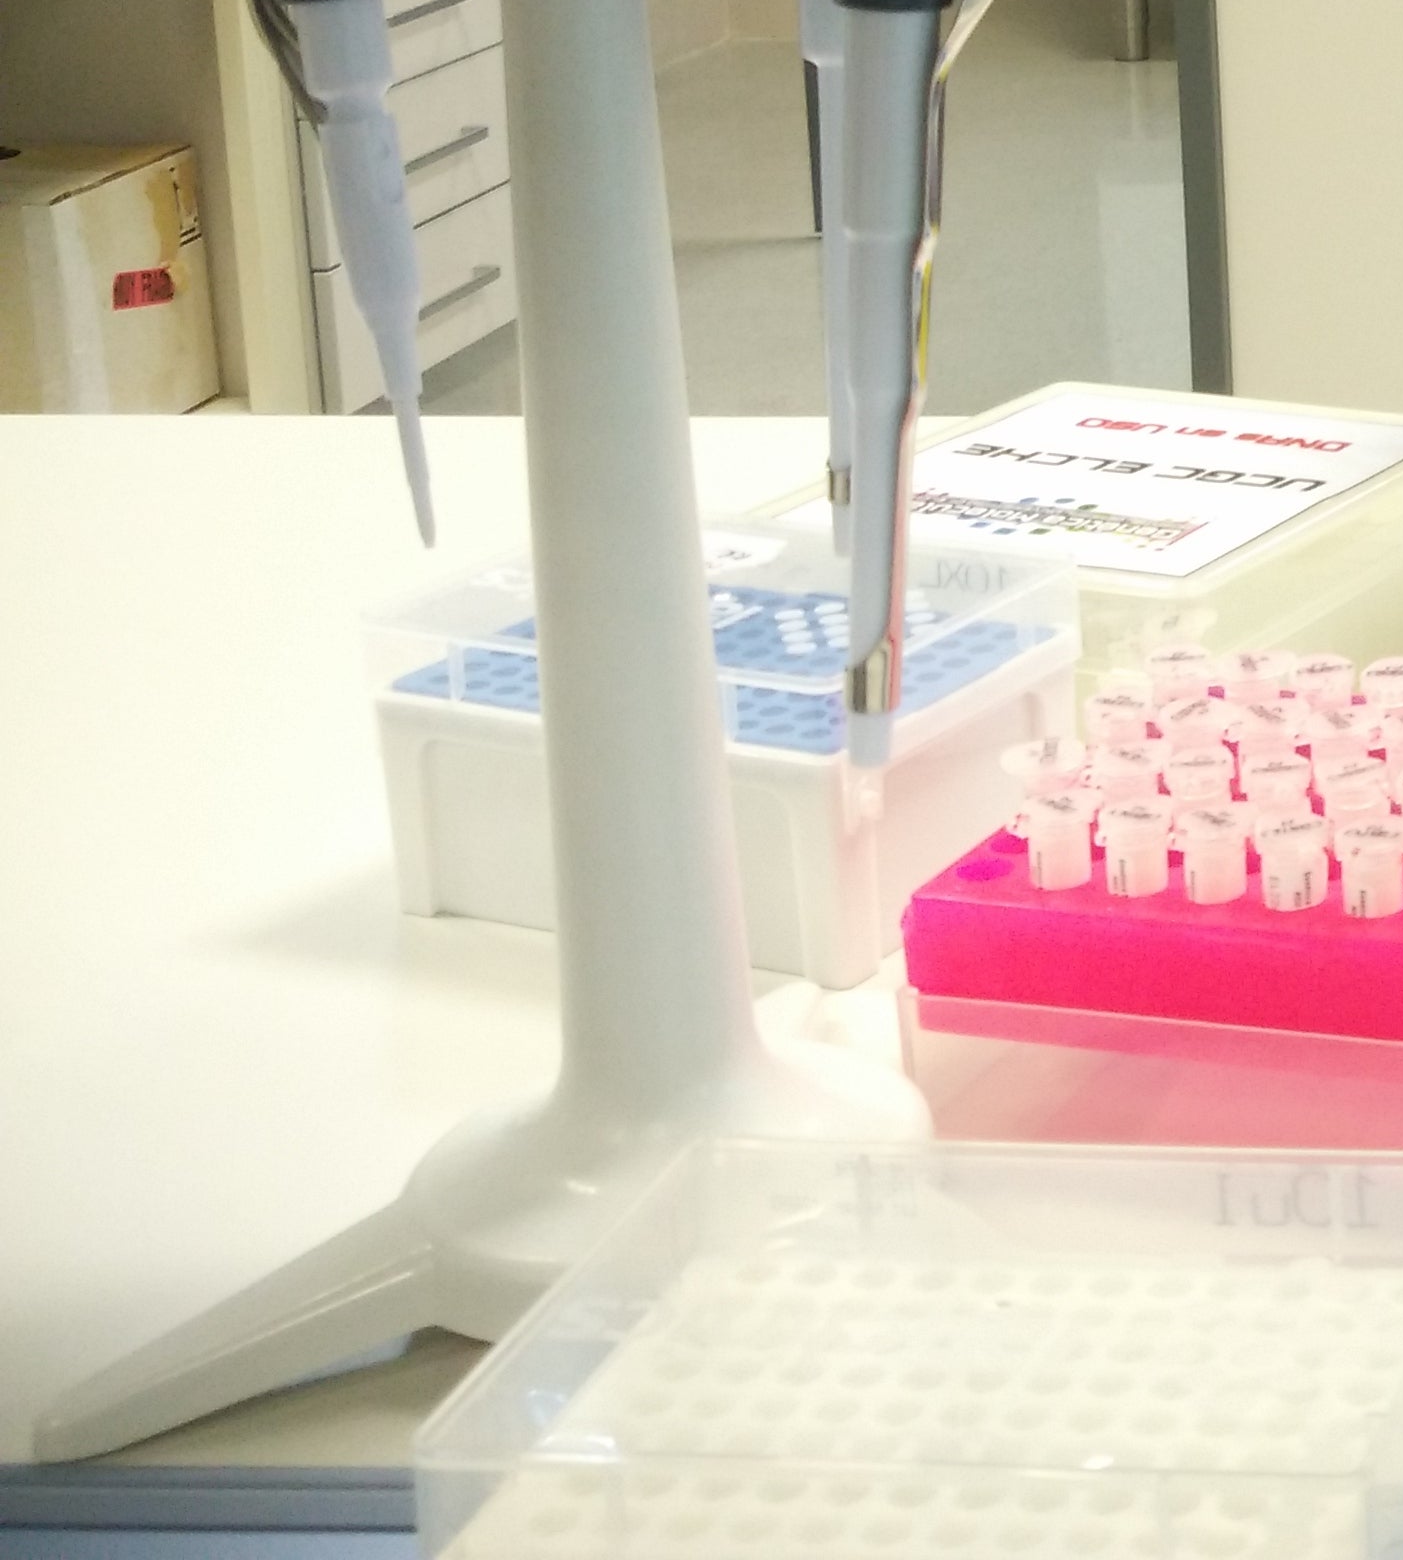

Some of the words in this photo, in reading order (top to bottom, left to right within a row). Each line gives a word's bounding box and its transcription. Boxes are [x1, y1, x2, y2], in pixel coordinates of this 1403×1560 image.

[1175, 426, 1227, 438] en
[953, 443, 1154, 474] ELCHE
[1154, 465, 1327, 492] UCGC
